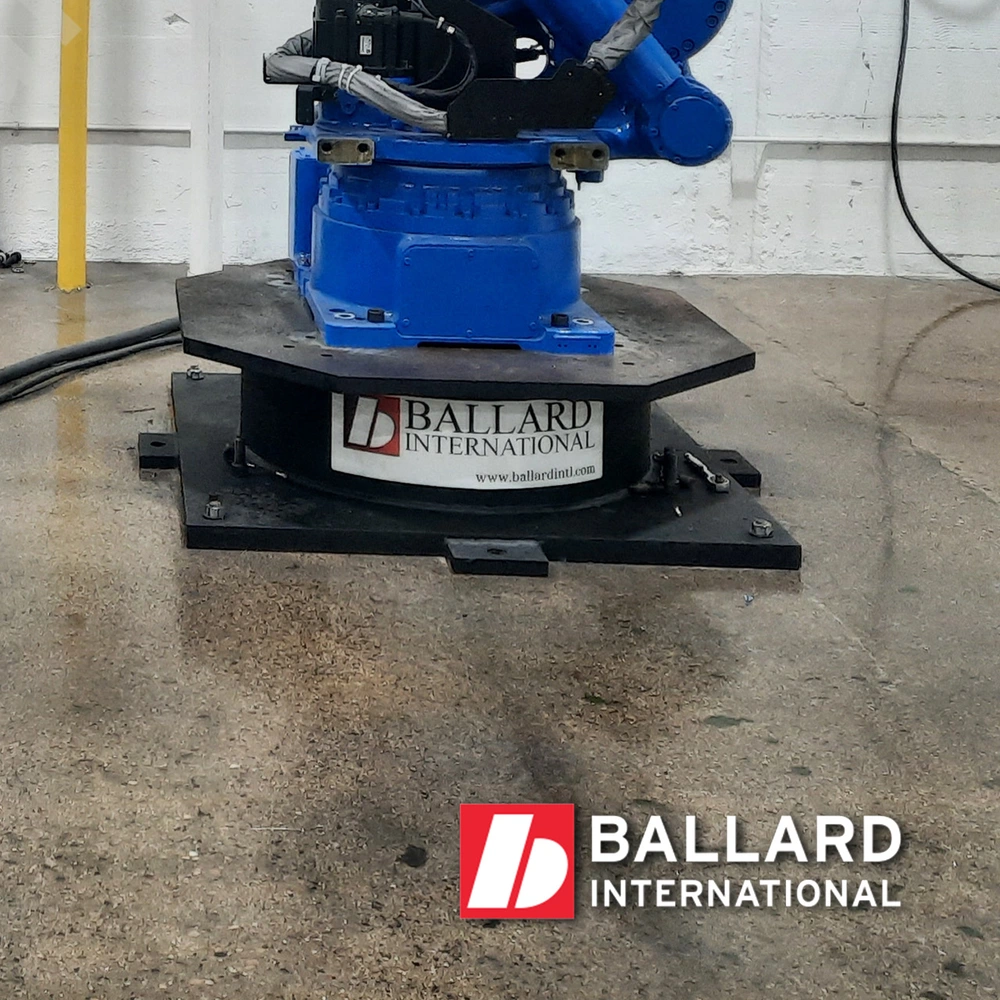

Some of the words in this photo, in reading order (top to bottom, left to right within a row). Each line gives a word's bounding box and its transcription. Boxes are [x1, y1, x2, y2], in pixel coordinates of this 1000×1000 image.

[404, 399, 593, 435] BALLARD
[405, 430, 596, 457] INTERNATIONAL
[475, 464, 596, 483] www.ballardintl.com
